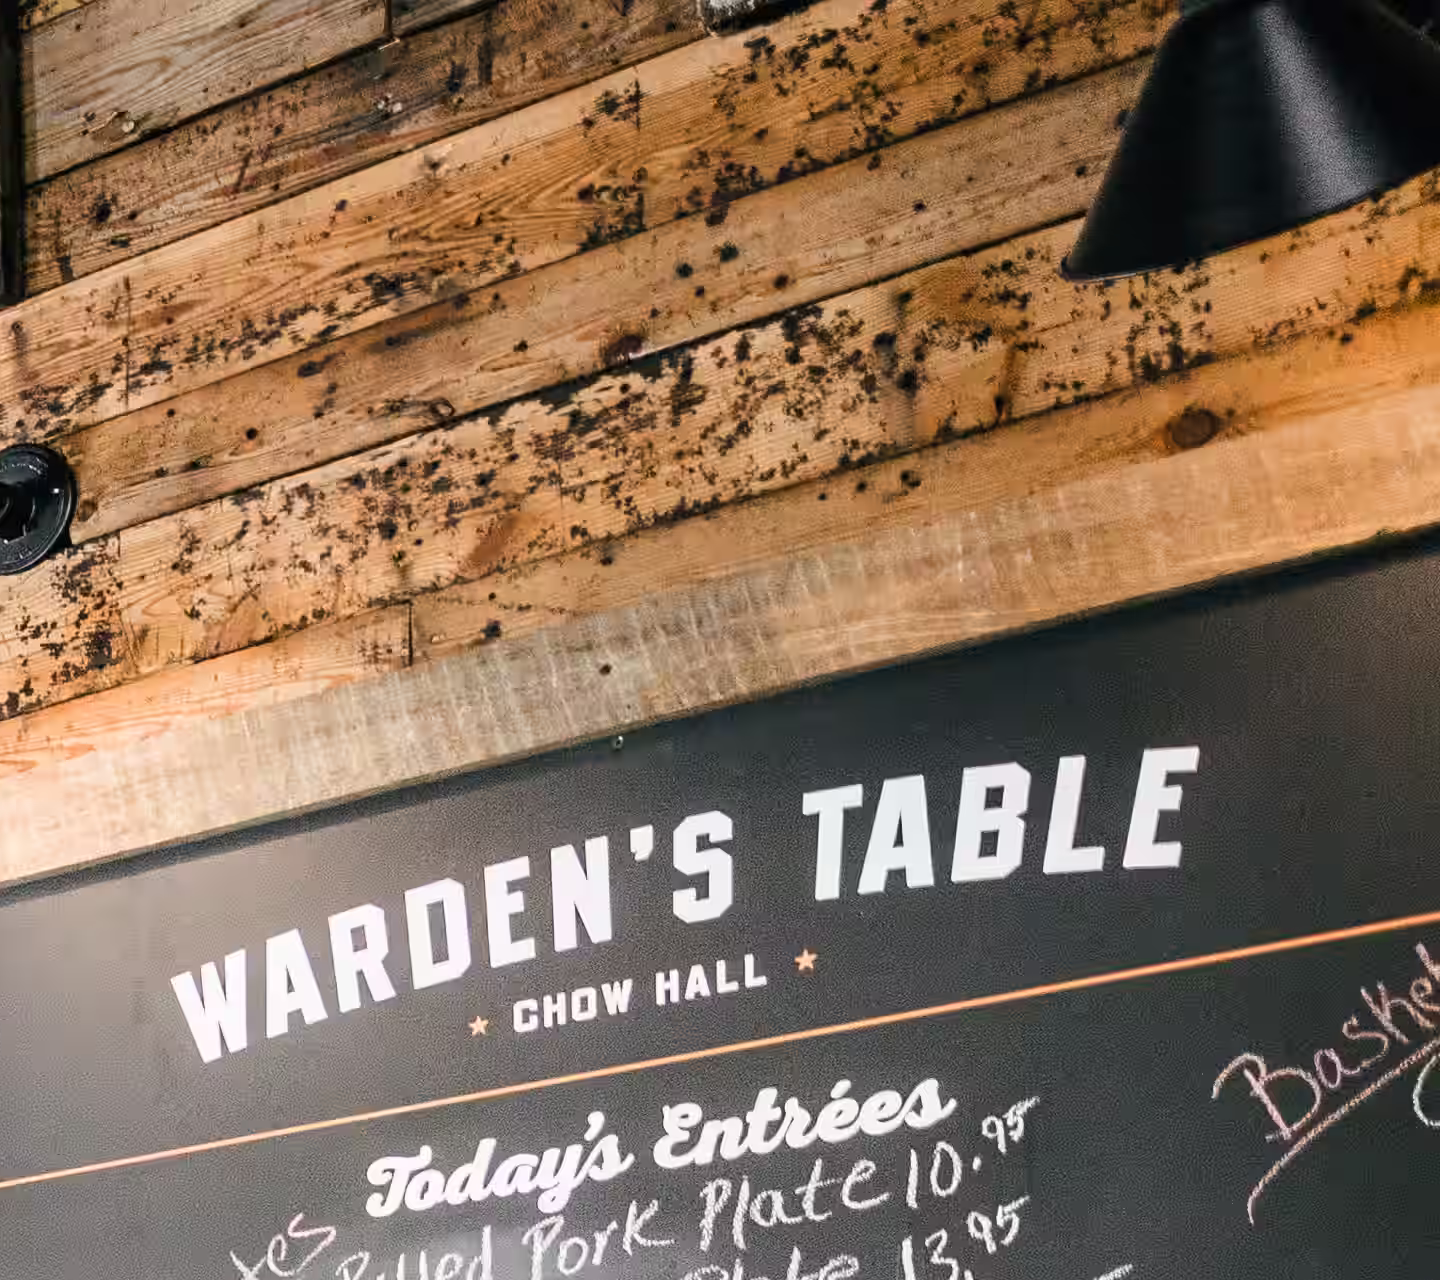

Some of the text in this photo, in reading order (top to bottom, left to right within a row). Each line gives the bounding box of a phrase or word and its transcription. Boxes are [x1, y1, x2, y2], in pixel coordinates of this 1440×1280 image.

[170, 746, 1200, 1064] WARDEN'S TABLE
[512, 954, 768, 1034] CHOW HALL
[366, 1077, 957, 1217] Today's Entrées
[699, 1157, 890, 1250] Plate
